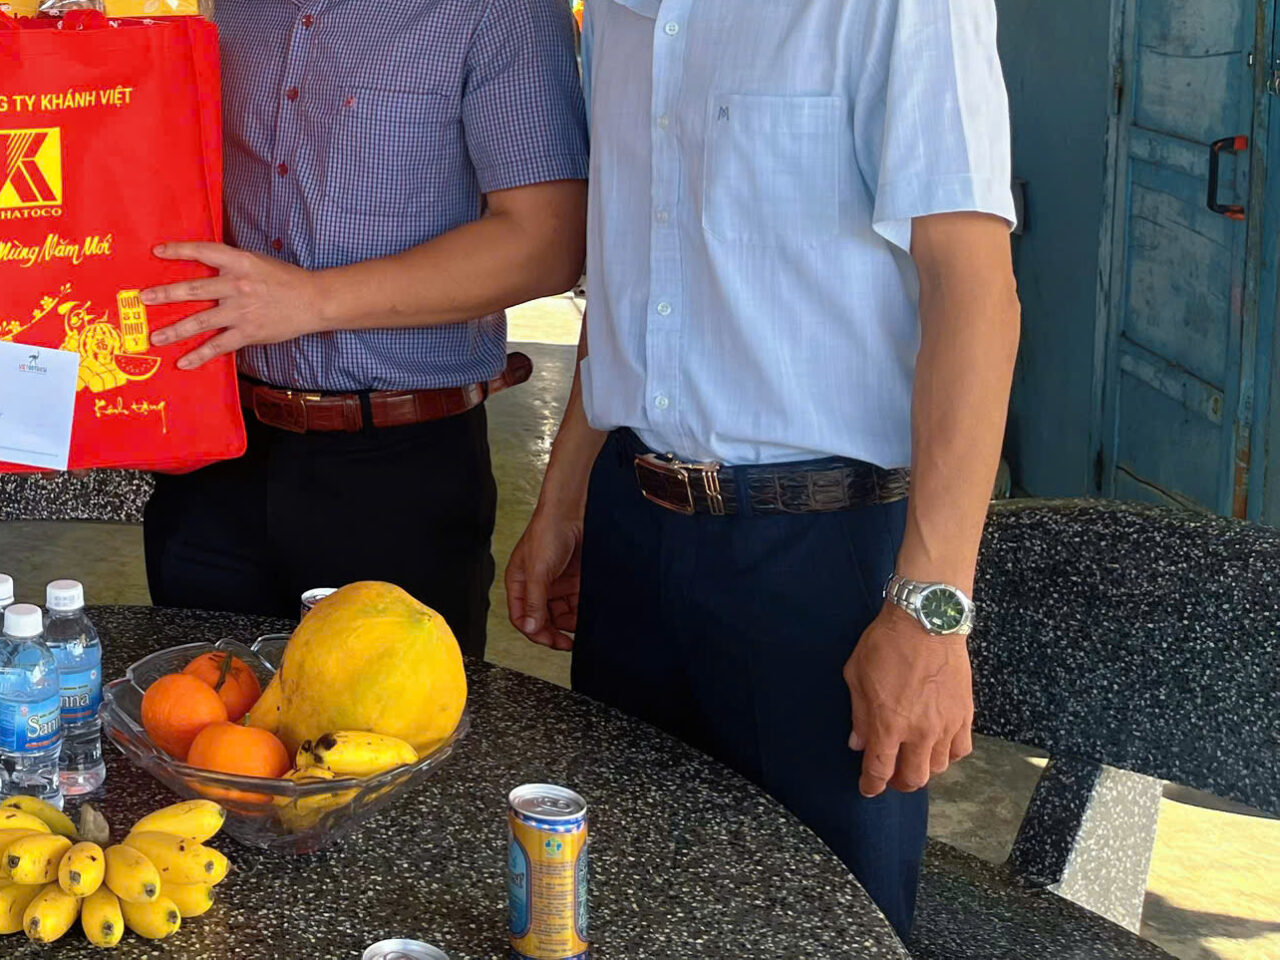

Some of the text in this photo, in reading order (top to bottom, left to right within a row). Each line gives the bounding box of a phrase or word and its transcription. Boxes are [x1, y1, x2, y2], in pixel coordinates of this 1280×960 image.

[12, 95, 36, 112] TY
[40, 88, 97, 111] KHÁNH
[99, 84, 133, 107] VIỆT
[37, 233, 83, 265] Năm
[81, 233, 112, 256] Mới
